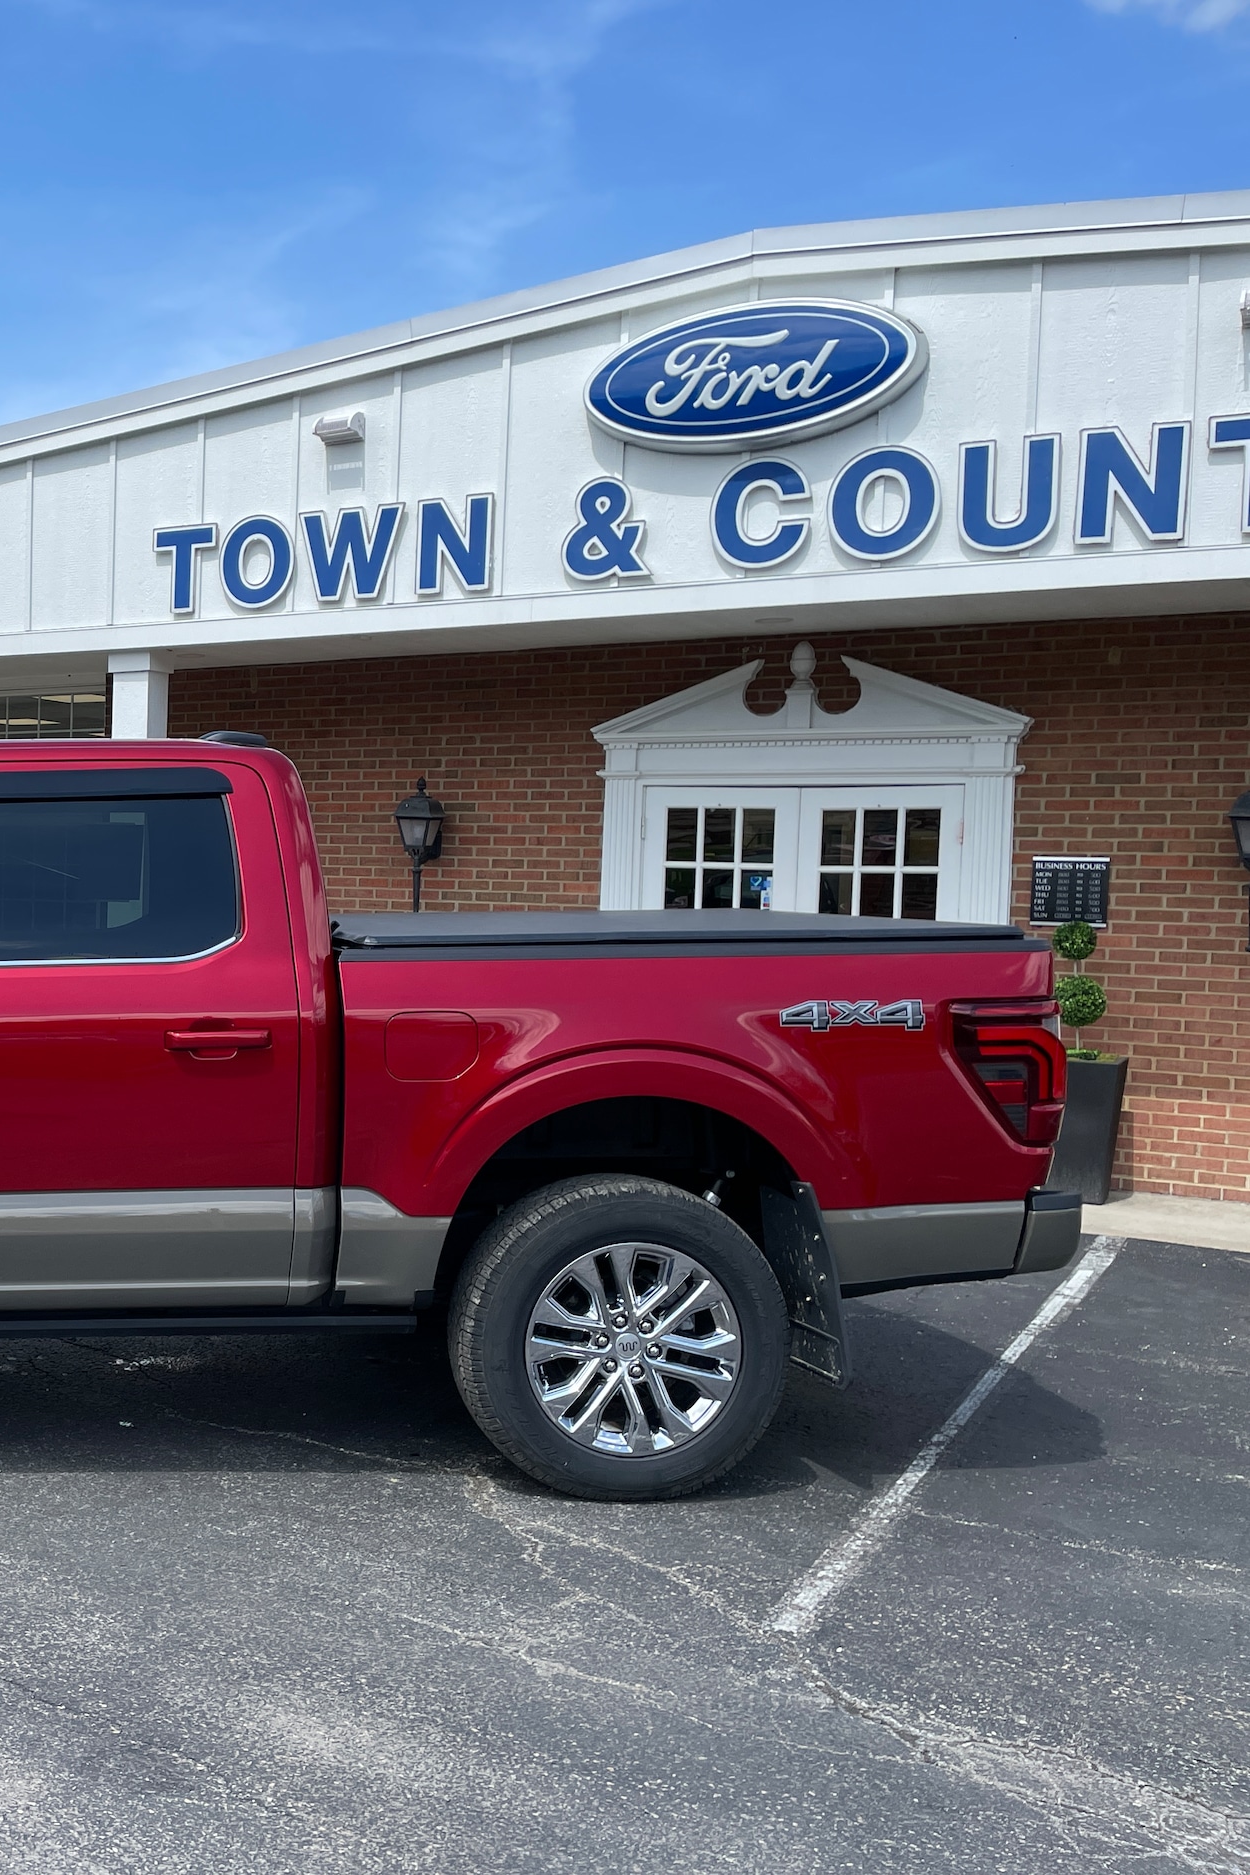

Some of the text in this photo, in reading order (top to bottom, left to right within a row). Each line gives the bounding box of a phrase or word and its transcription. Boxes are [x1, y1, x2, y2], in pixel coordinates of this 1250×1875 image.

[644, 328, 841, 418] Ford
[153, 492, 495, 614] TOWN
[561, 475, 653, 581] &
[1035, 862, 1073, 870] BUSINESS
